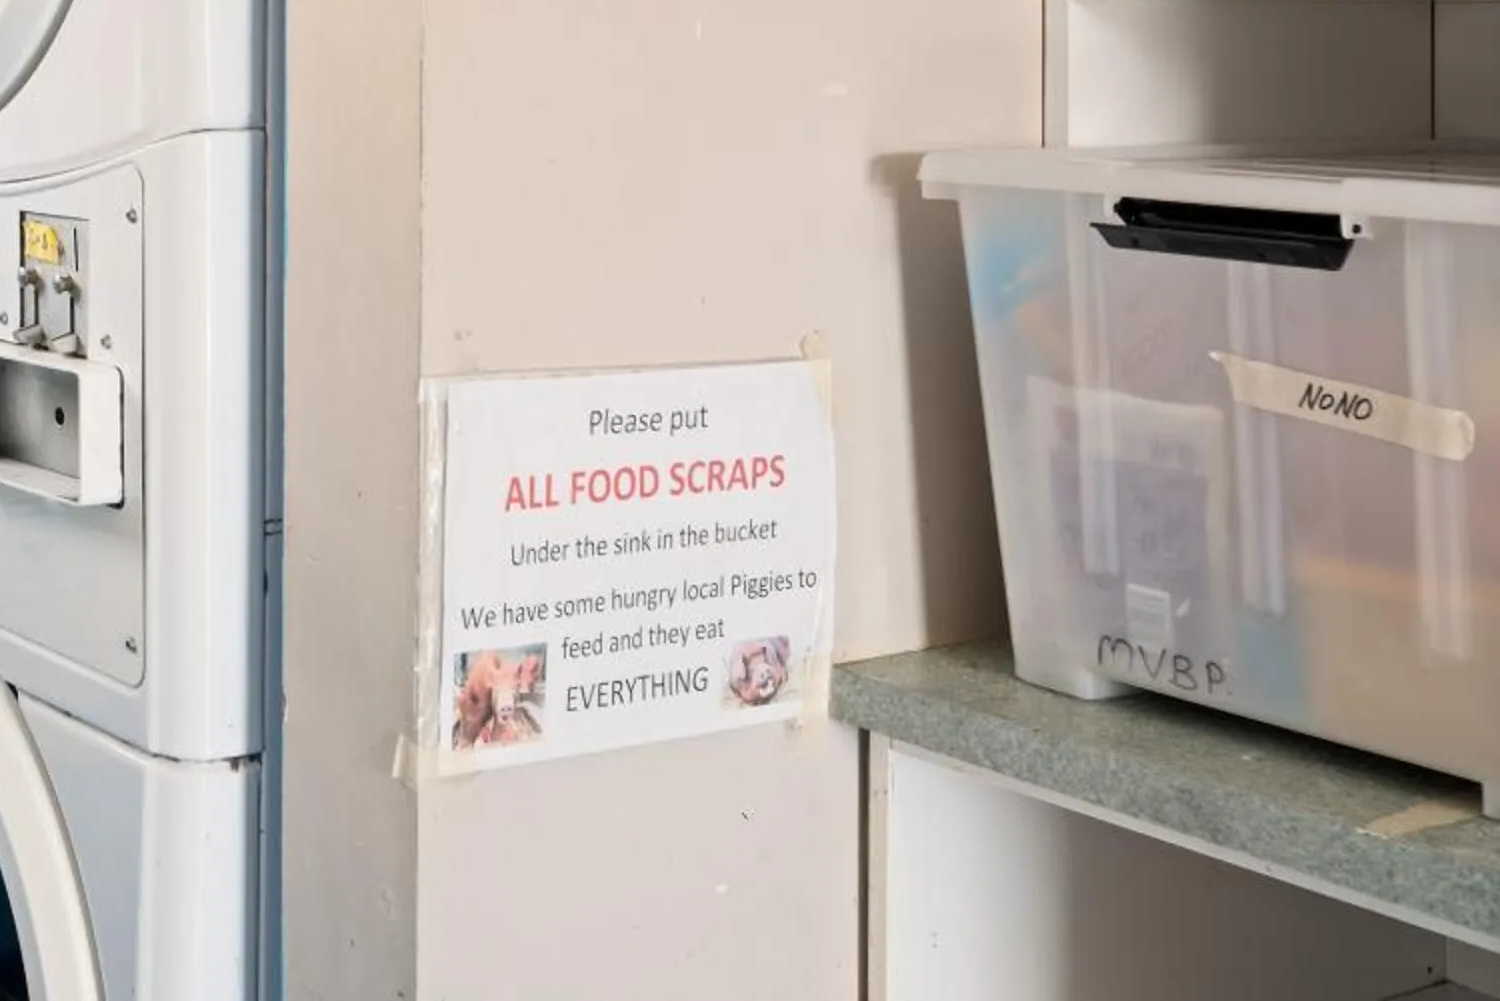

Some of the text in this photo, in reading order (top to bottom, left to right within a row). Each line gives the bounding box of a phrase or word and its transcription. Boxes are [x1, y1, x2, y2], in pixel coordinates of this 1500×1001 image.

[590, 405, 708, 436] Please put
[505, 455, 785, 512] ALL FOOD SCRAPS
[511, 519, 778, 566] Under the sink in the bucket
[462, 568, 817, 630] We have some hungry local Piggies to
[562, 618, 724, 659] feed and they eat
[566, 667, 709, 711] EVERYTHING
